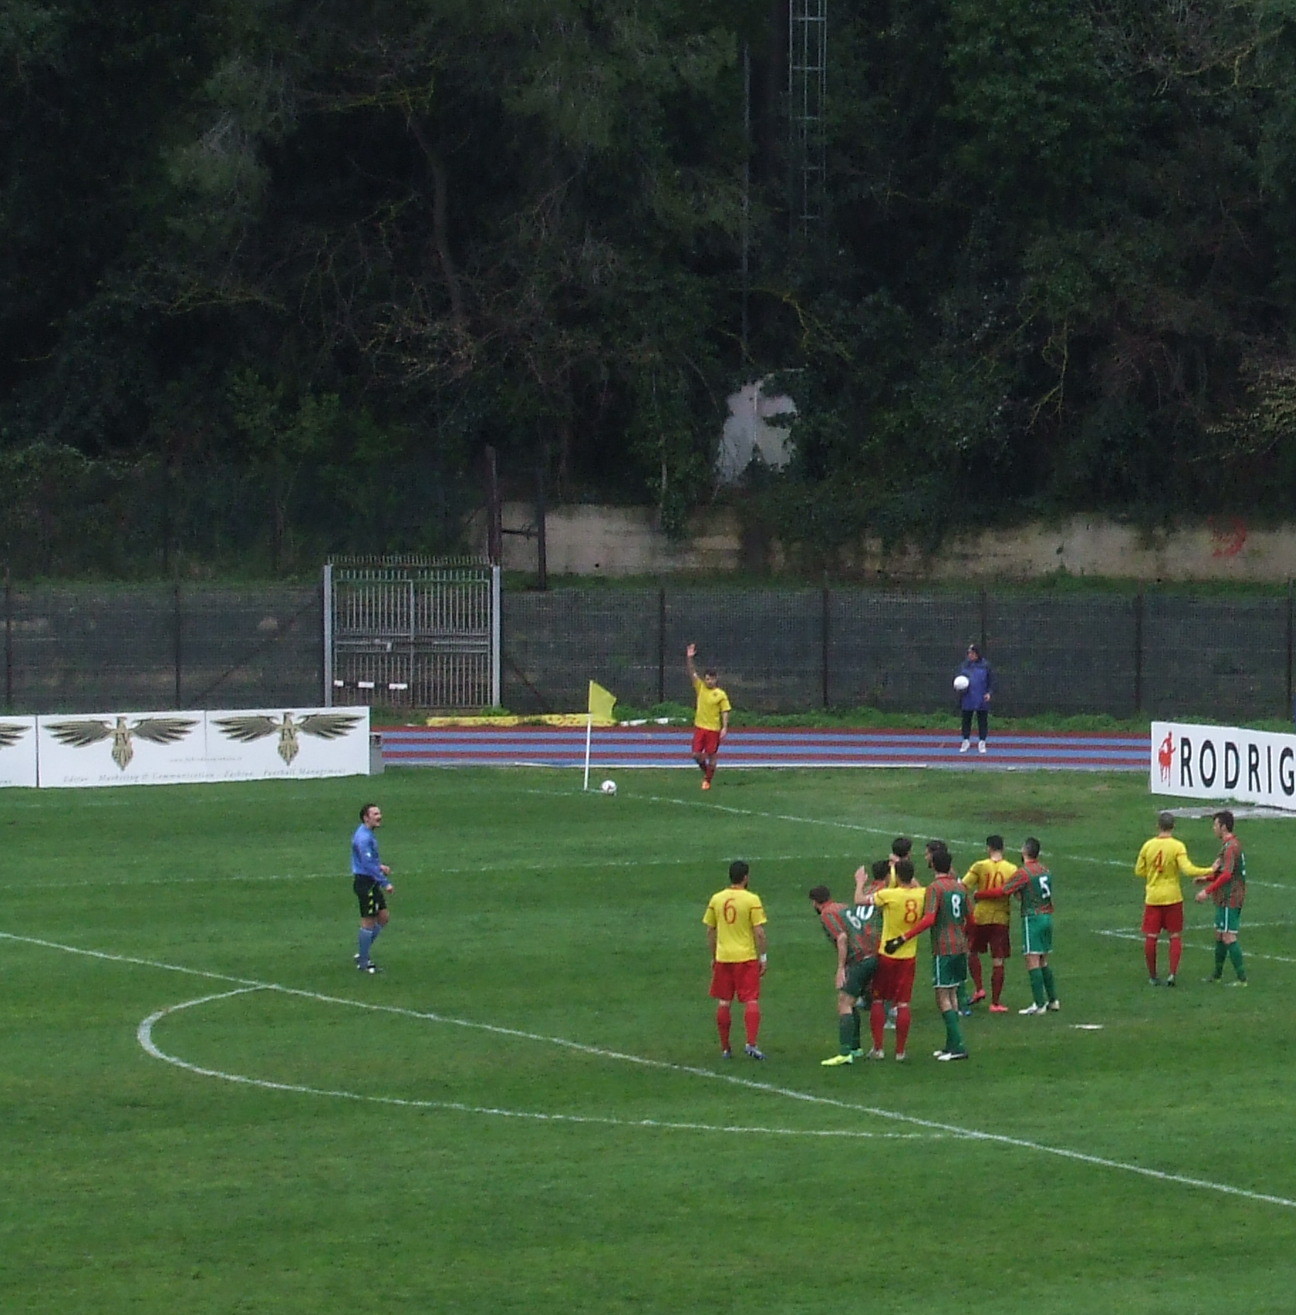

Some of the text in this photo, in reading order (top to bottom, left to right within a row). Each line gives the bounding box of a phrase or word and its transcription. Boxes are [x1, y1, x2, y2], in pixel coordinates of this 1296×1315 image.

[1154, 849, 1166, 874] 4
[1039, 875, 1051, 899] 5
[722, 897, 738, 925] 6
[904, 898, 918, 924] 8
[950, 893, 962, 918] 8
[845, 909, 862, 930] 6
